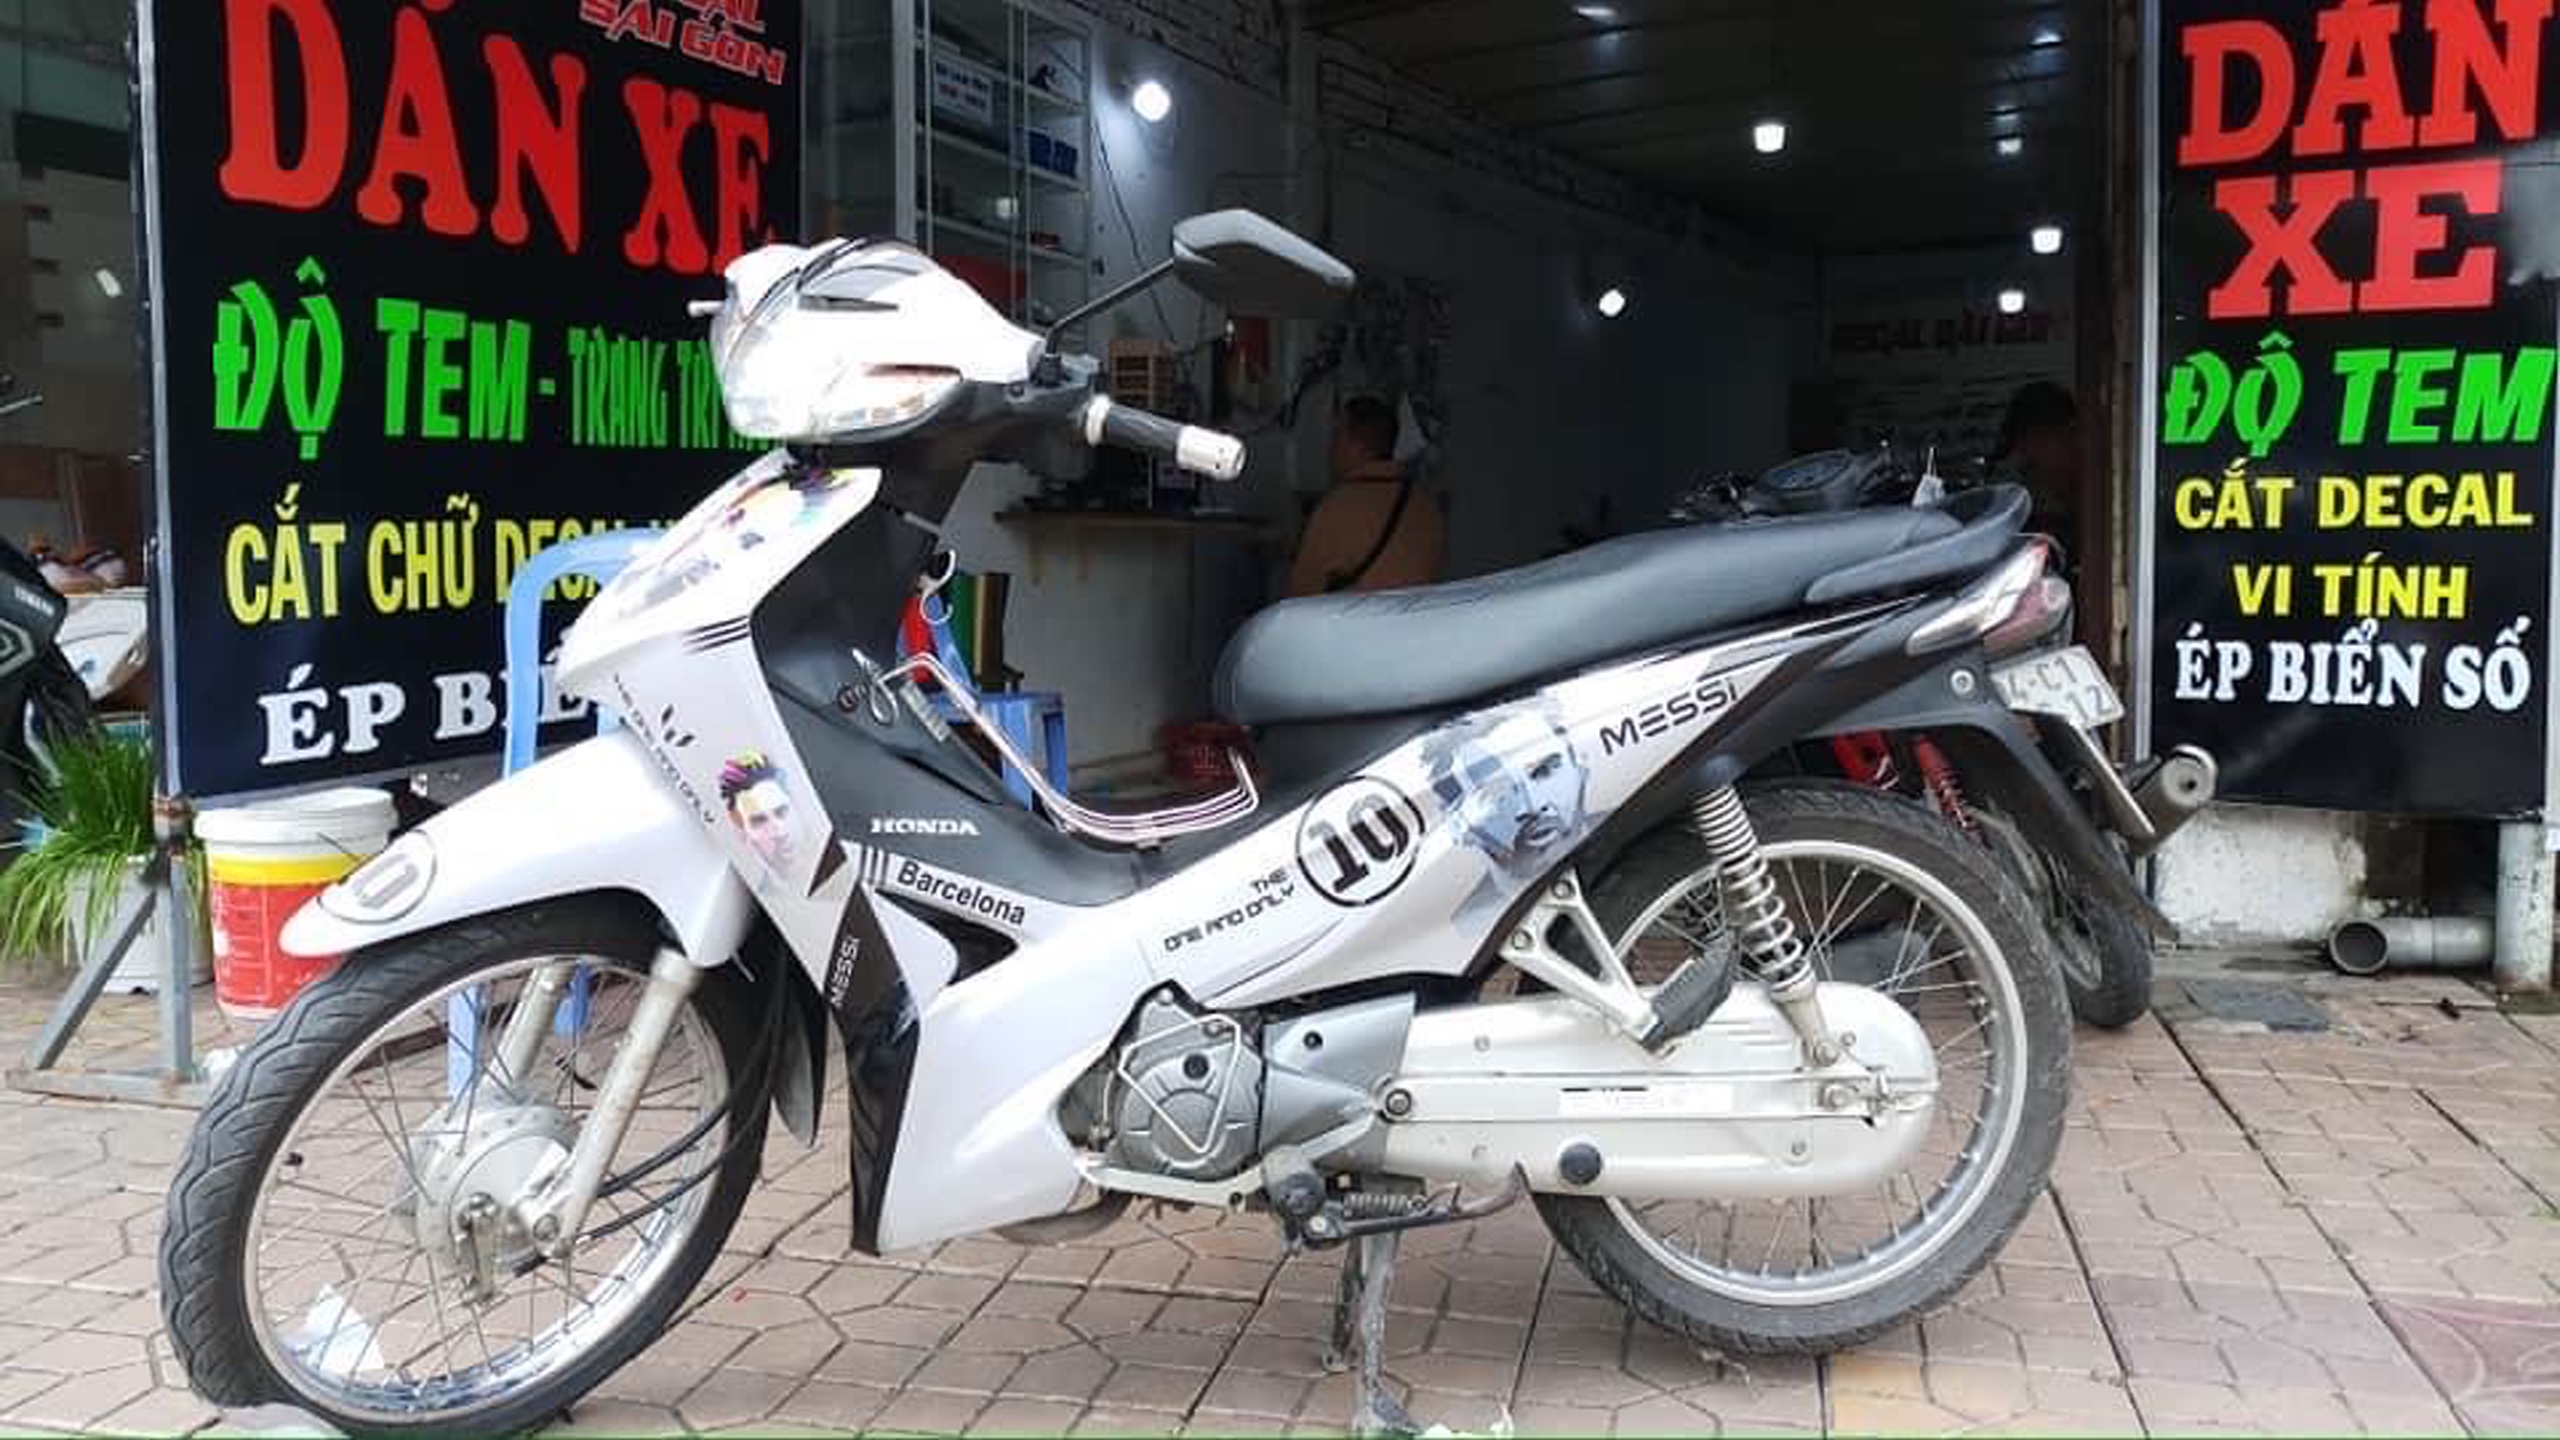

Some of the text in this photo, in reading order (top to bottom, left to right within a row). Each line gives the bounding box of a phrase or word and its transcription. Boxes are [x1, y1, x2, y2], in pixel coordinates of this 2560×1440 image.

[623, 77, 772, 276] XE
[2207, 157, 2504, 319] XE
[213, 257, 344, 461] ĐỘ
[2164, 331, 2558, 457] ĐỘ TEM
[2175, 458, 2534, 529] CẮT DECAL
[225, 482, 346, 625] CẮT
[367, 492, 480, 614] CHỮ
[2233, 552, 2468, 619] VI TÍNH
[2175, 616, 2532, 711] ÉP BIỂN SỐ
[257, 663, 407, 767] ÉP
[870, 817, 981, 837] HONDA
[1307, 793, 1411, 894] 10
[898, 860, 1026, 926] Barcelona
